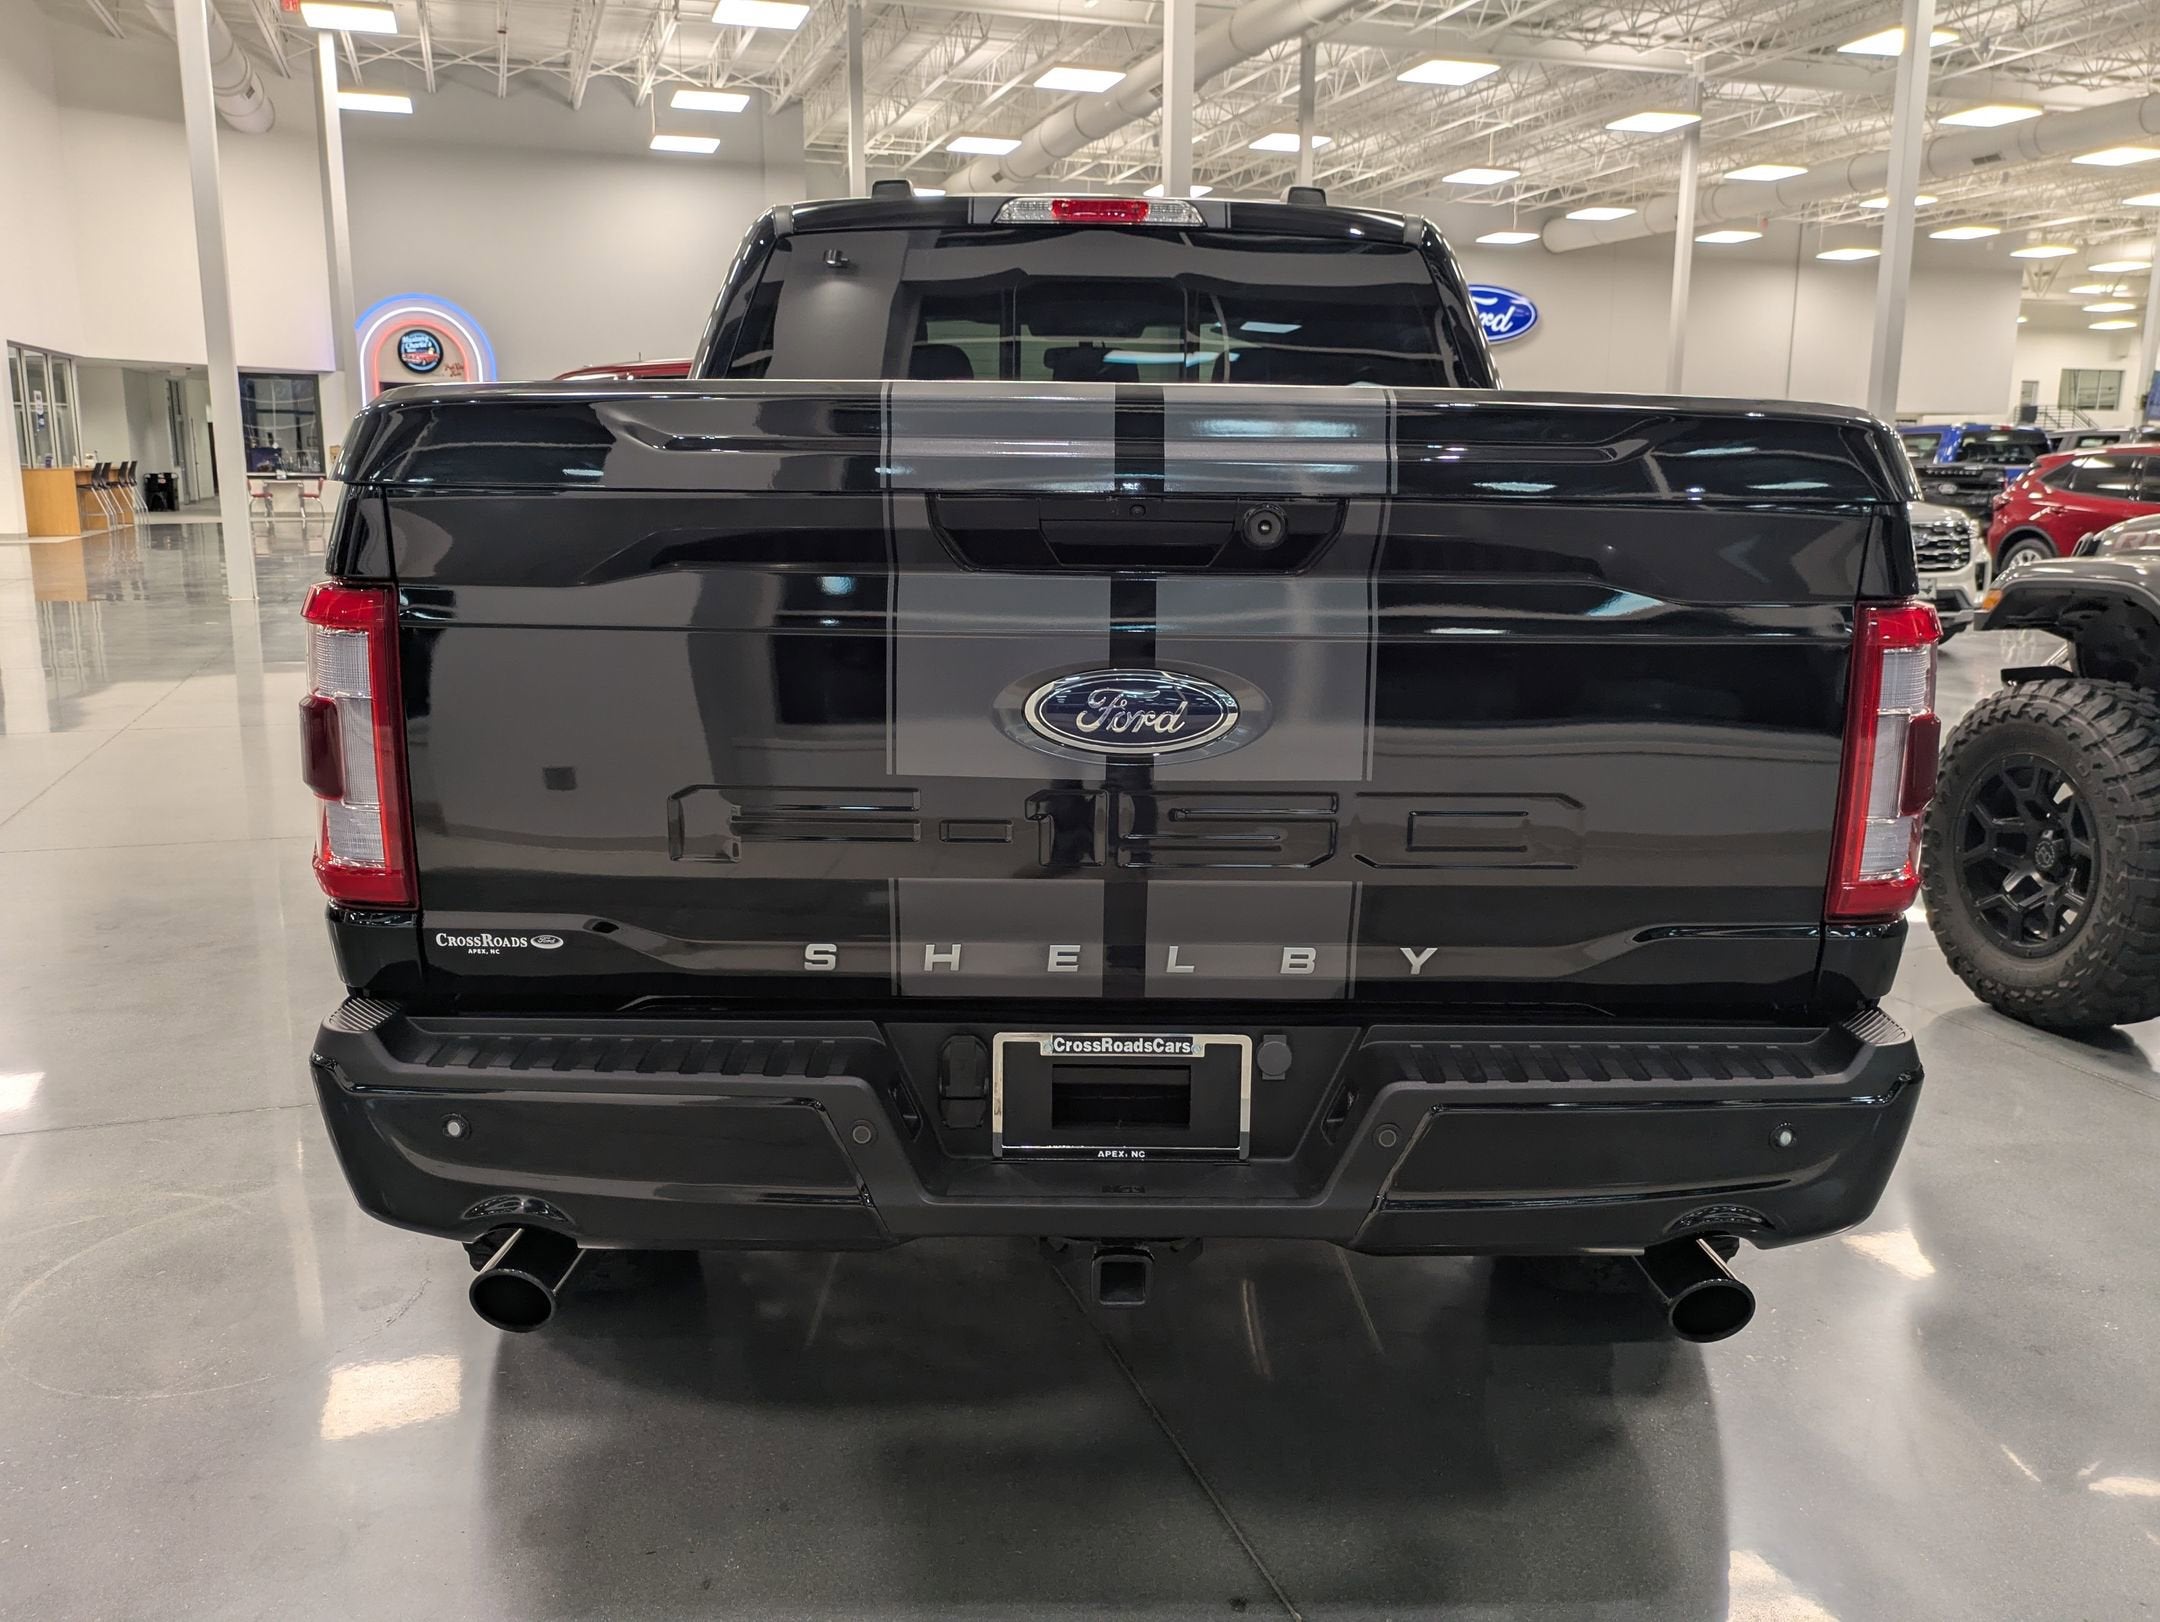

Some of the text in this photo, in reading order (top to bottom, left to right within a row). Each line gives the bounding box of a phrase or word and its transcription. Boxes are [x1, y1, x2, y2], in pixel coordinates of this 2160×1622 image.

[1075, 687, 1188, 734] Ford
[667, 785, 1583, 868] F-150
[803, 942, 1438, 975] SHELBY
[1053, 1037, 1191, 1054] CrossRoadsCars
[1097, 1150, 1146, 1158] APEX, NC
